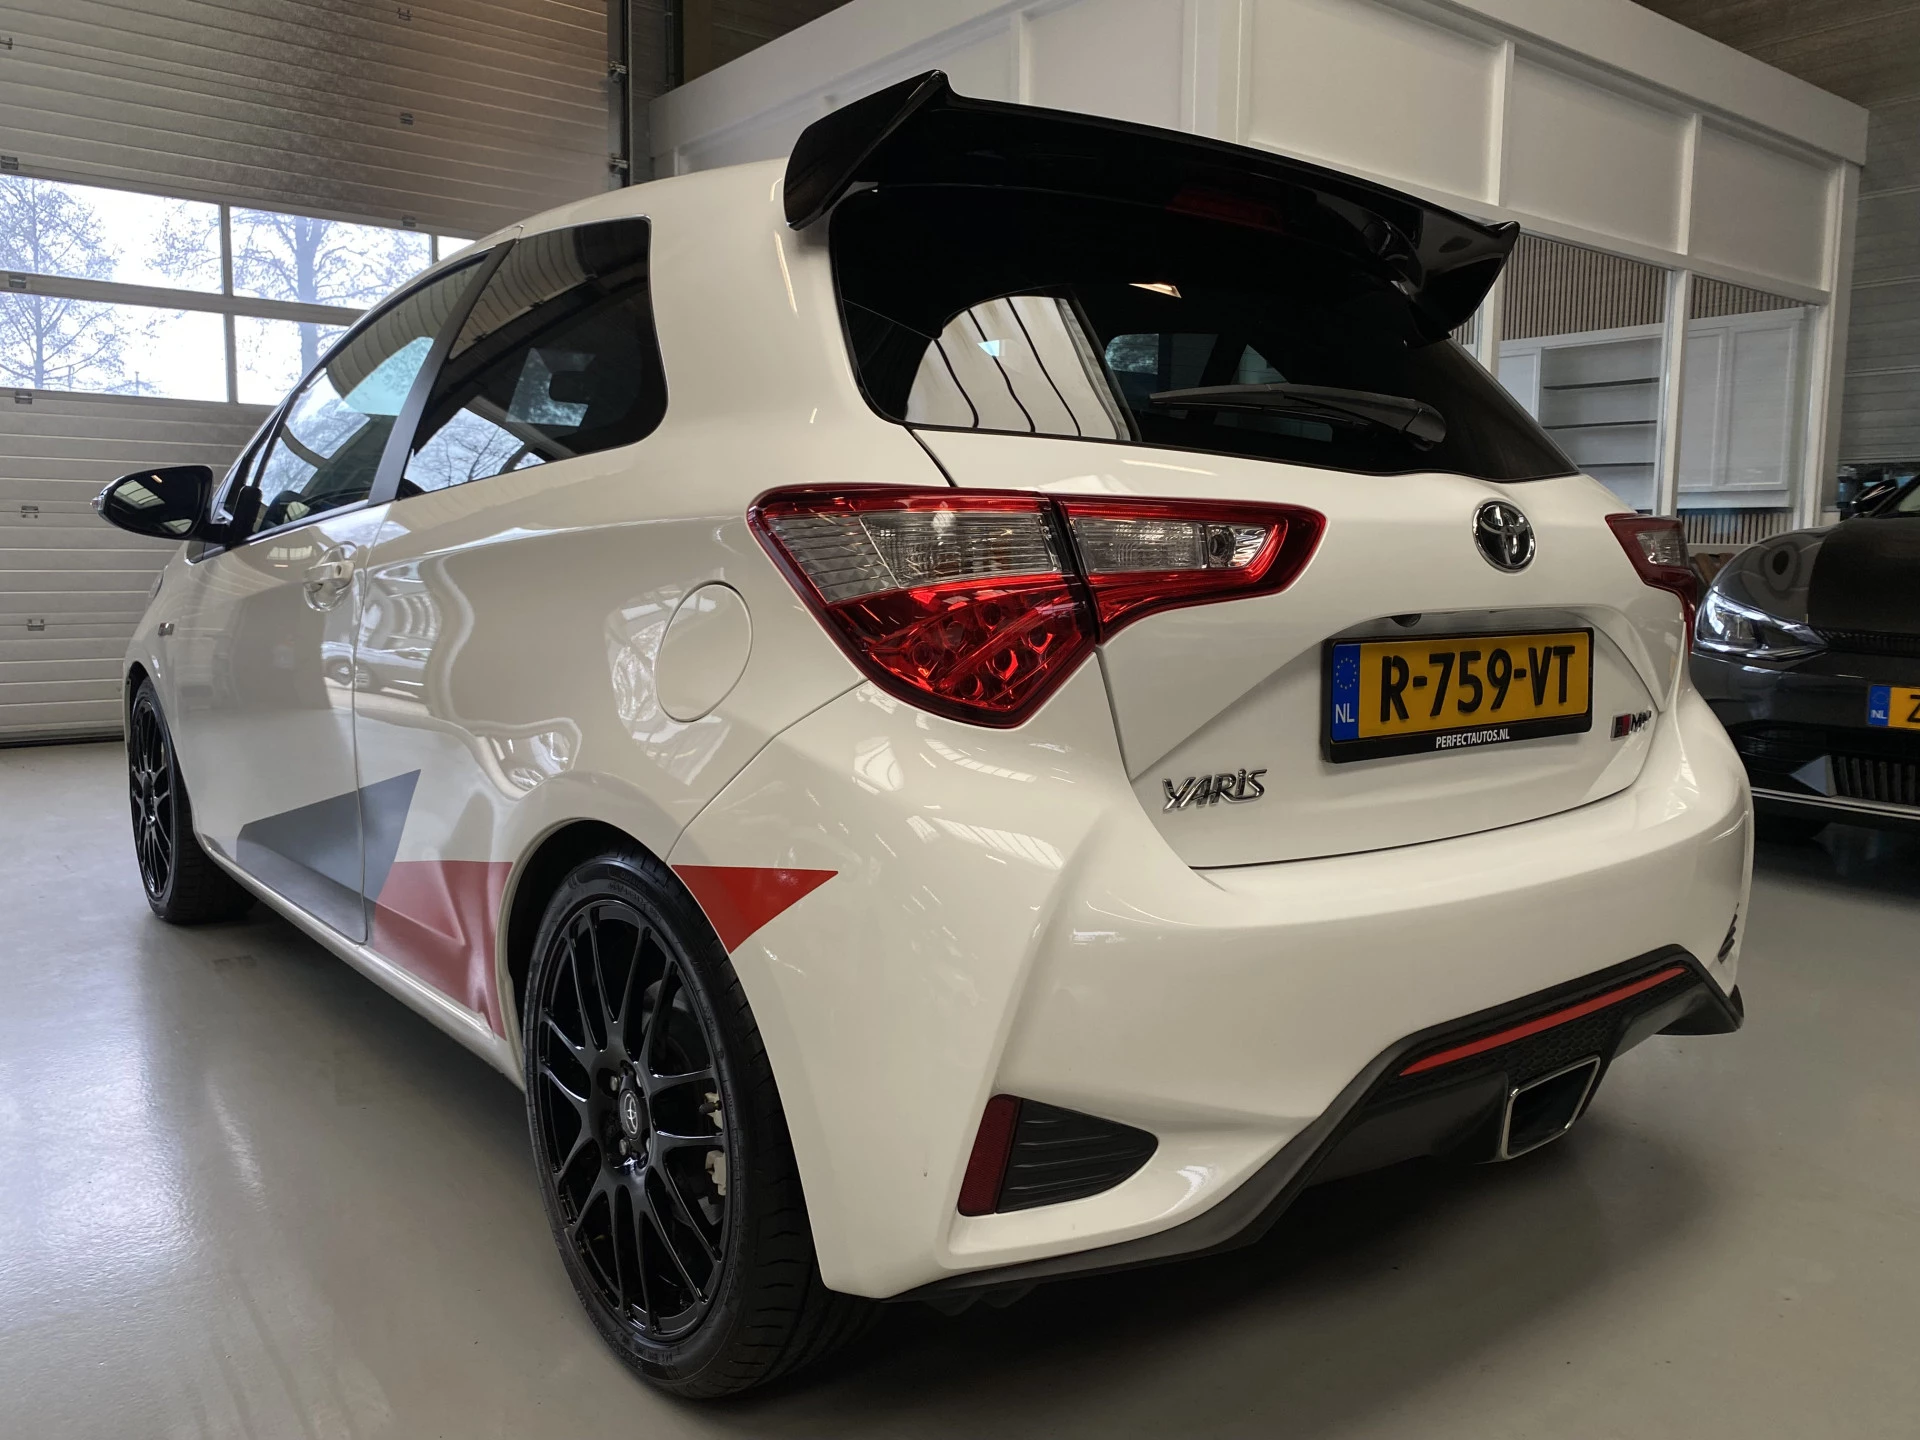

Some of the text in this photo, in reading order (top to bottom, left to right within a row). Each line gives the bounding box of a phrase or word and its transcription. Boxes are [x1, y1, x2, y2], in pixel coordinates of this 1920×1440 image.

[1380, 645, 1575, 723] R-759-VT
[1335, 703, 1355, 724] NL
[1871, 709, 1887, 719] NL
[1436, 728, 1510, 749] PERFECTAUTOS.NL
